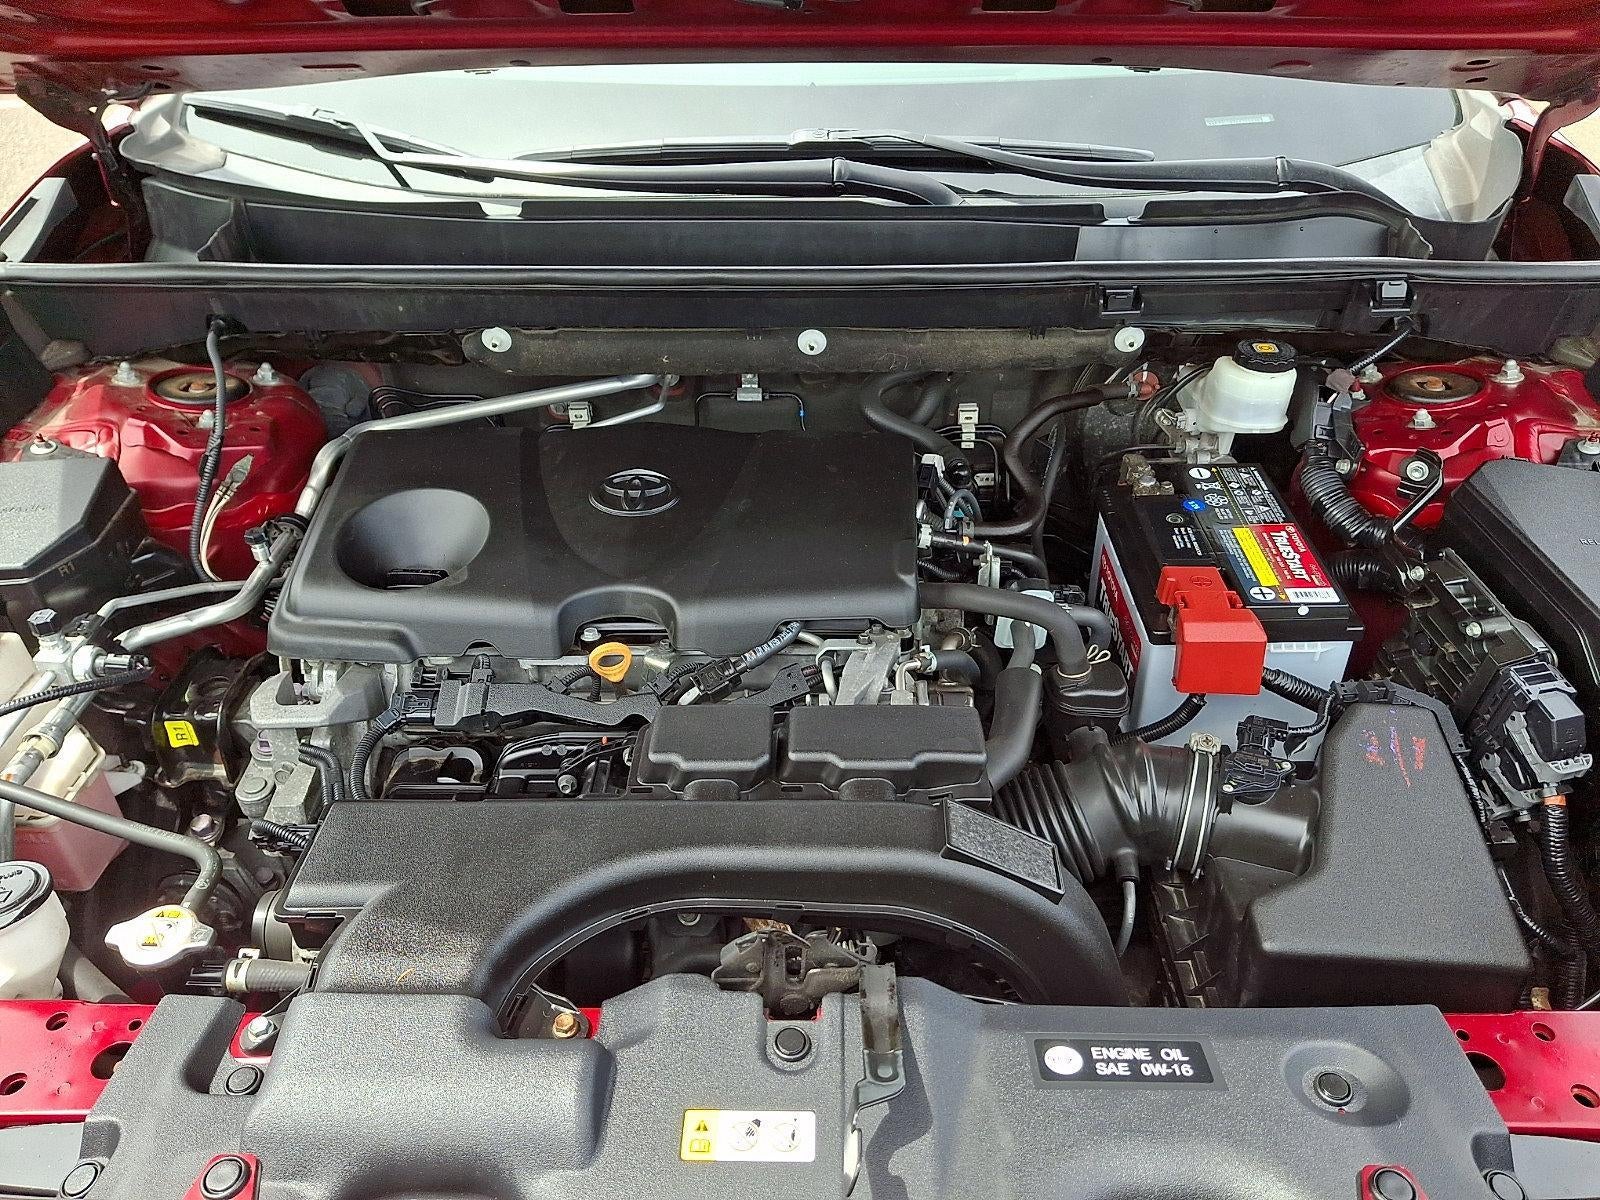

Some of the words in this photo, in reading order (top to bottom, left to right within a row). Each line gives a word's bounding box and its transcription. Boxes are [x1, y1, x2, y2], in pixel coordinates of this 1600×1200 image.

[1290, 531, 1307, 553] TOYOTA
[173, 727, 188, 741] R1
[1090, 1046, 1152, 1060] ENGINE
[1160, 1048, 1190, 1061] OIL
[1095, 1062, 1132, 1076] SAE
[1140, 1063, 1194, 1077] 0W-16
